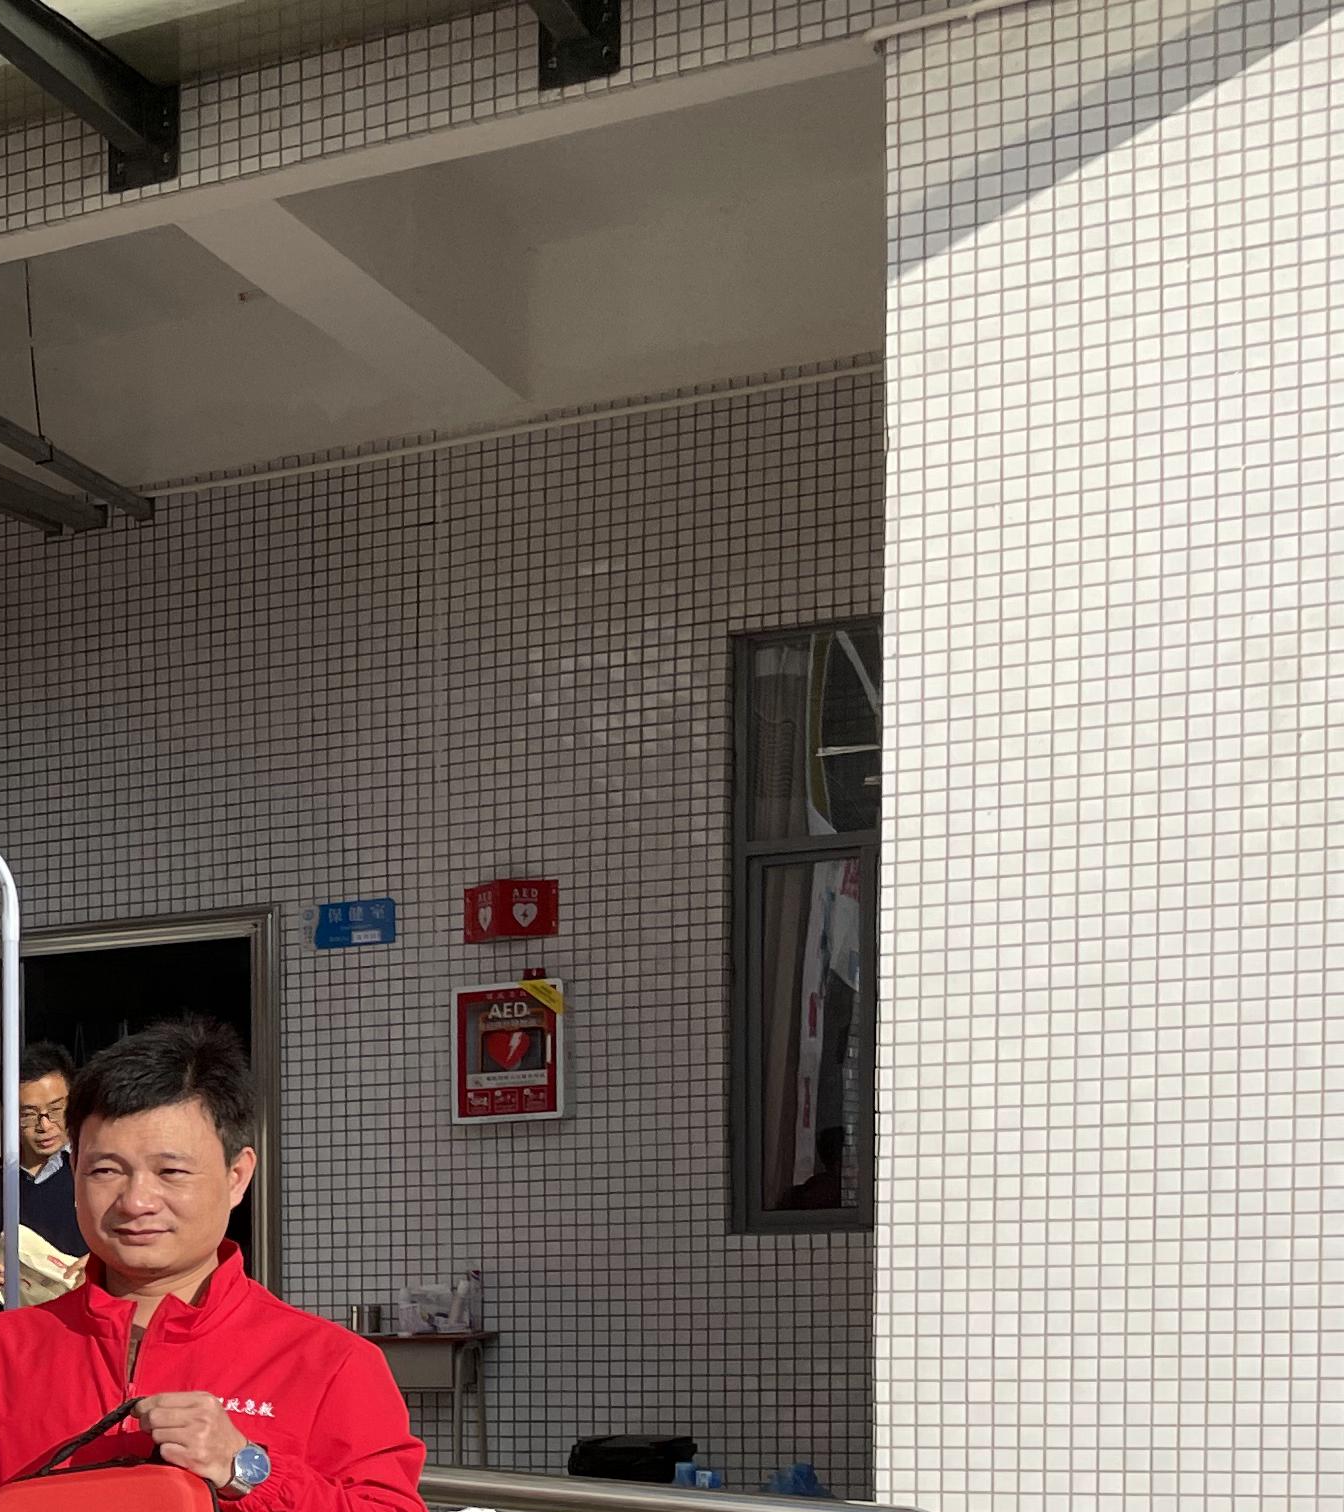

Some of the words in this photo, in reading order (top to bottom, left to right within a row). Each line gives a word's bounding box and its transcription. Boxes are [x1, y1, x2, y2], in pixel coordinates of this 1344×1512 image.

[512, 888, 538, 898] AED
[488, 1002, 528, 1019] AED
[216, 1397, 276, 1418] 致急救
